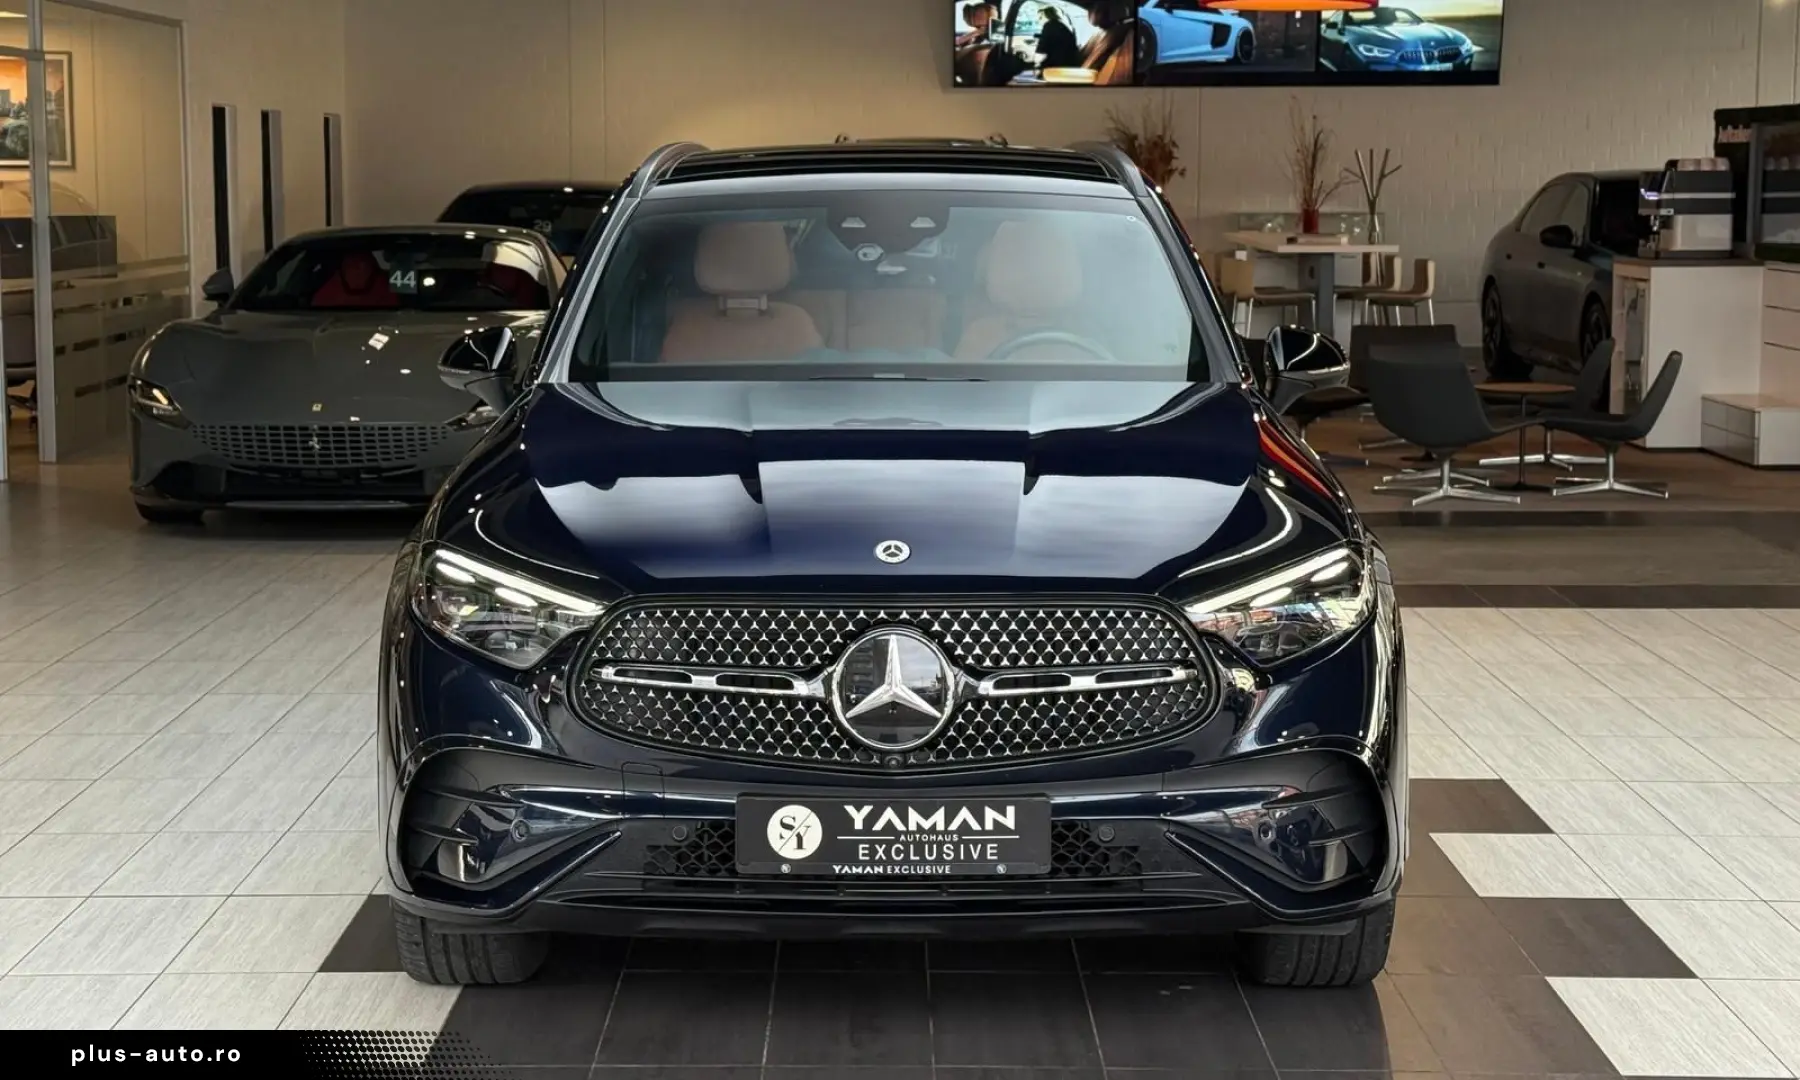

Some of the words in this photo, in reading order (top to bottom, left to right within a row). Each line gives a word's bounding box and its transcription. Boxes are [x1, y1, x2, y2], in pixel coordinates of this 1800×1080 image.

[389, 269, 417, 288] 44
[843, 804, 1016, 831] YAMAN
[899, 833, 960, 842] AUTOHAUS
[858, 843, 999, 861] EXCLUSIVE
[832, 864, 884, 874] YAMAN
[886, 864, 952, 874] EXCLUSIVE
